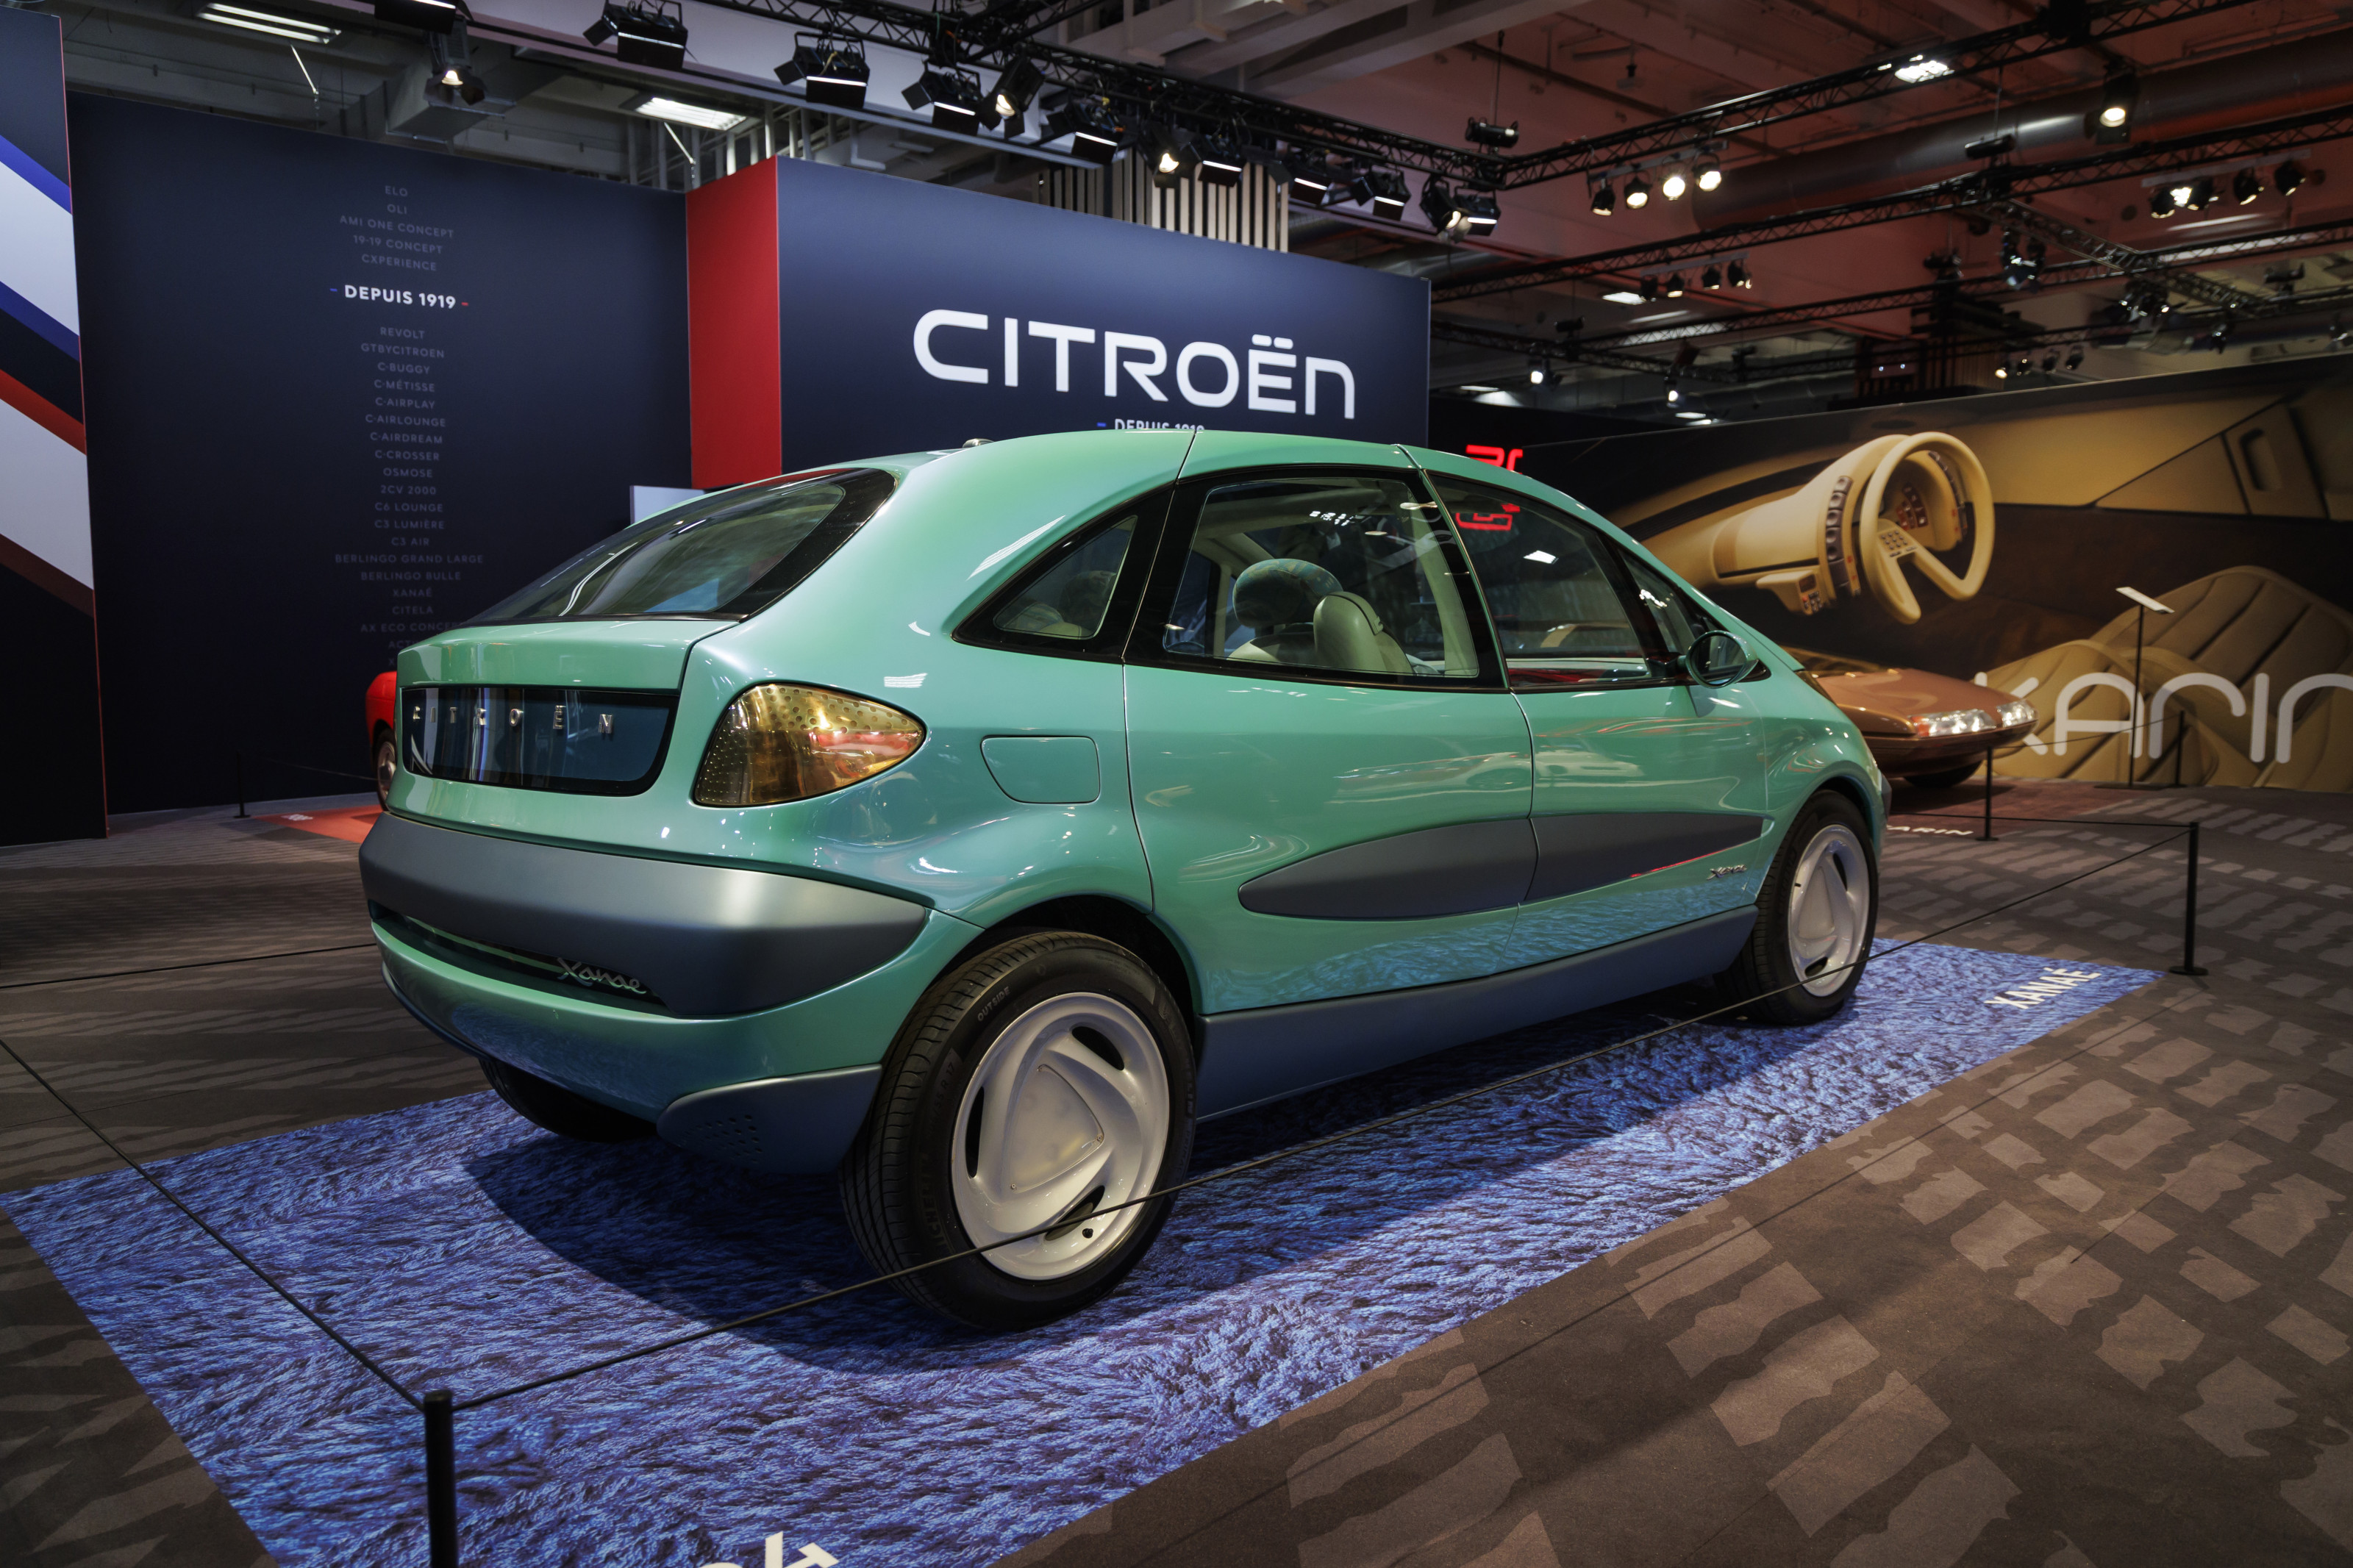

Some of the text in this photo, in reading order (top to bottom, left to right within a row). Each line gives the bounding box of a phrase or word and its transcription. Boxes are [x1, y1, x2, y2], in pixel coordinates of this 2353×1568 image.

[385, 185, 408, 197] ELO
[387, 204, 407, 215] OLI
[340, 215, 454, 238] AMI ONE CONCEPT
[353, 235, 443, 254] 19-19 CONCEPT
[362, 254, 437, 271] CXPERIENCE
[345, 284, 456, 309] DEPUIS 1919
[380, 326, 425, 340] REVOLT
[361, 343, 445, 358] GTBYCITROEN
[377, 362, 430, 374] C-BUGGY
[913, 309, 1355, 420] CITROËN
[374, 379, 435, 392] C-MÉTISSE
[375, 397, 435, 409] C-AIRPLAY
[365, 414, 446, 427] C-AIRLOUNGE
[370, 432, 443, 444] C-AIRDREAM
[375, 450, 440, 461] C-CROSSER
[383, 468, 433, 478] OSMOSE
[380, 485, 437, 495] 2CV 2000
[375, 502, 443, 512] C6 LOUNGE
[374, 518, 445, 530] C3 LUMIÈRE
[391, 537, 429, 546] C3 AIR
[335, 554, 483, 564] BERLINGO GRAND LARGE
[361, 571, 461, 581] BERLINGO BULLE
[393, 587, 432, 598] XANAÉ
[392, 606, 434, 615] CITELA
[360, 622, 463, 633] AX ECO CONCE
[977, 986, 1011, 1022] OUTSIDE
